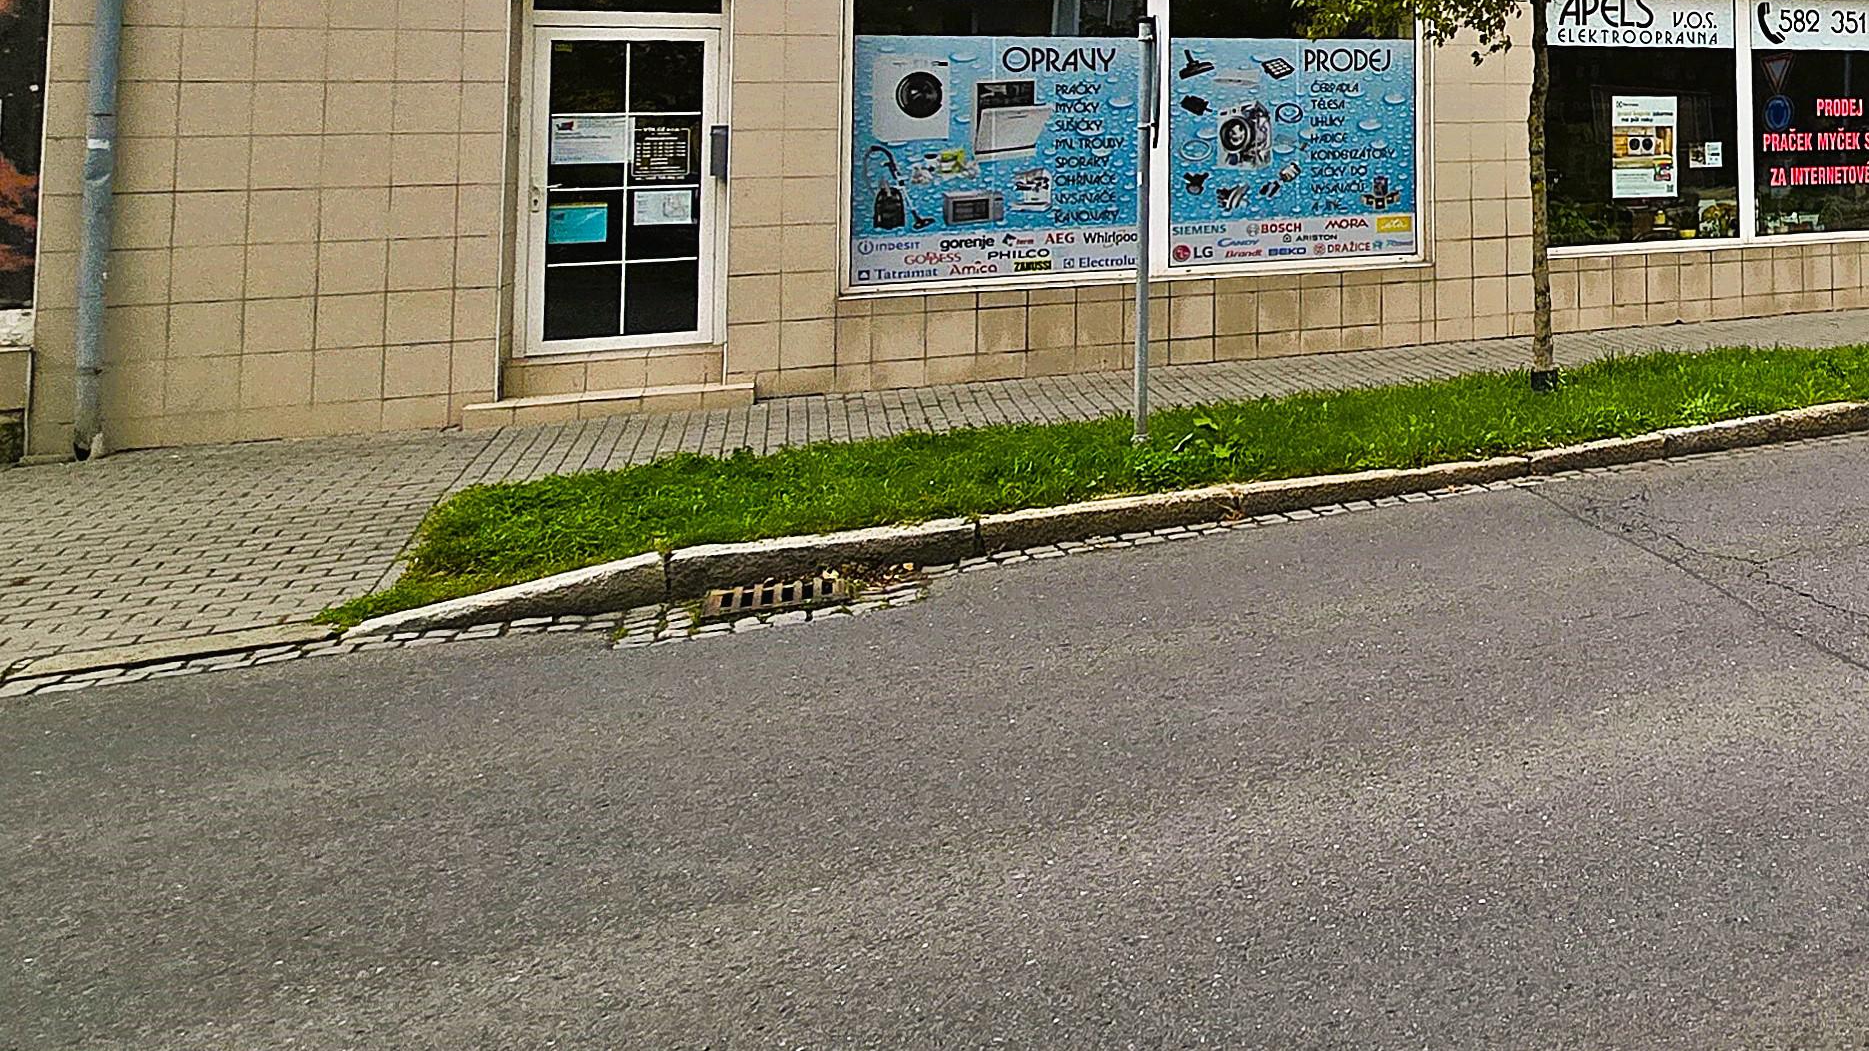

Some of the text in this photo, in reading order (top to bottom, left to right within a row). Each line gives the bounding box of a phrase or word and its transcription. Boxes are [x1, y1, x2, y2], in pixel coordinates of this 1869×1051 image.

[1779, 9, 1820, 33] 582
[1830, 10, 1866, 34] 351
[1557, 28, 1718, 46] ELEKTROOPRAVNA
[1002, 46, 1116, 73] OPRAVY
[1304, 48, 1391, 73] PRODEJ
[1055, 81, 1101, 95] PRAČKY
[1055, 99, 1099, 114] MYČKY
[1816, 99, 1863, 117] PRODEJ
[1055, 116, 1103, 132] SUŠIČKY
[1763, 129, 1812, 152] PRAČEK
[1818, 128, 1860, 150] MYČEK
[1770, 167, 1787, 187] ZA
[1172, 224, 1227, 236] SIEMENS
[1261, 223, 1302, 234] BOSCH
[1325, 218, 1369, 230] MORA
[940, 235, 995, 252] gorenje
[1045, 233, 1075, 245] AEG
[1083, 232, 1138, 246] Whirlpoo
[1295, 234, 1338, 242] ARISTON
[987, 248, 1050, 260] PHILCO
[1193, 246, 1213, 259] LG
[1327, 240, 1371, 254] DRAŽICE
[949, 261, 998, 276] Amica
[1079, 255, 1137, 269] Electrolu
[875, 268, 938, 280] Tatramat
